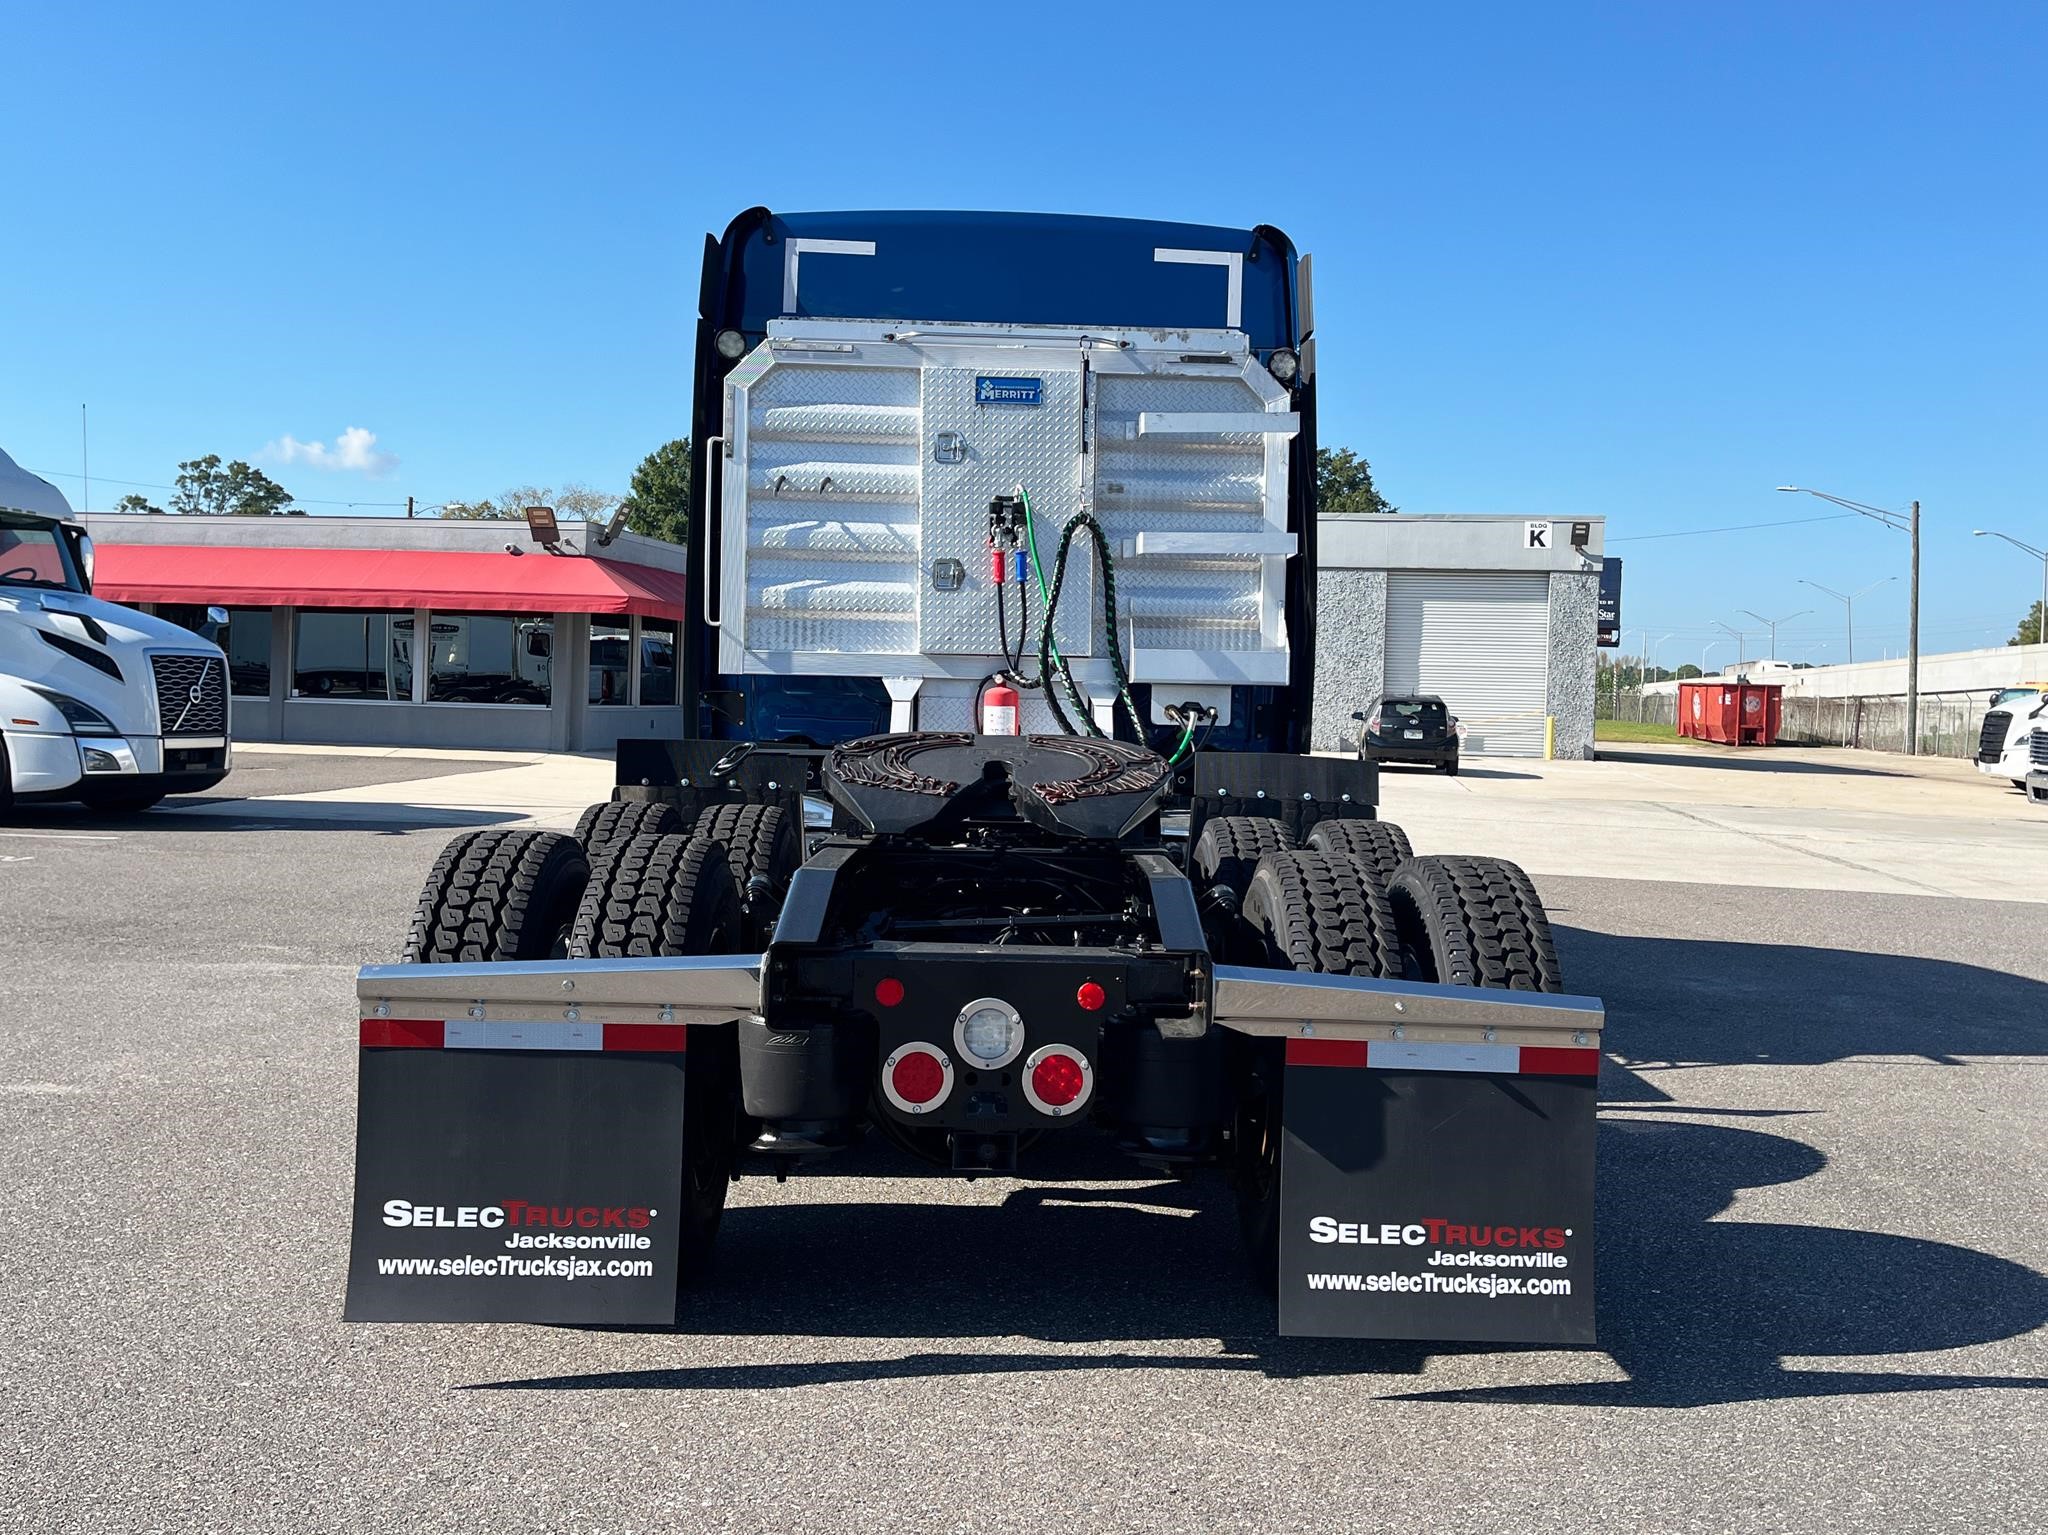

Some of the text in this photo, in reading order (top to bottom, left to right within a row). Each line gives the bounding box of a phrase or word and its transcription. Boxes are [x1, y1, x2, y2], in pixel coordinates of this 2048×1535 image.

[981, 389, 1035, 399] MERRITT
[1529, 530, 1546, 547] K
[1598, 608, 1616, 619] Star
[505, 1232, 651, 1249] Jacksonville
[378, 1254, 653, 1281] www.selecTrucksjax.com
[1427, 1250, 1568, 1269] Jacksonville
[1307, 1271, 1571, 1298] www.selecTrucksjax.com
